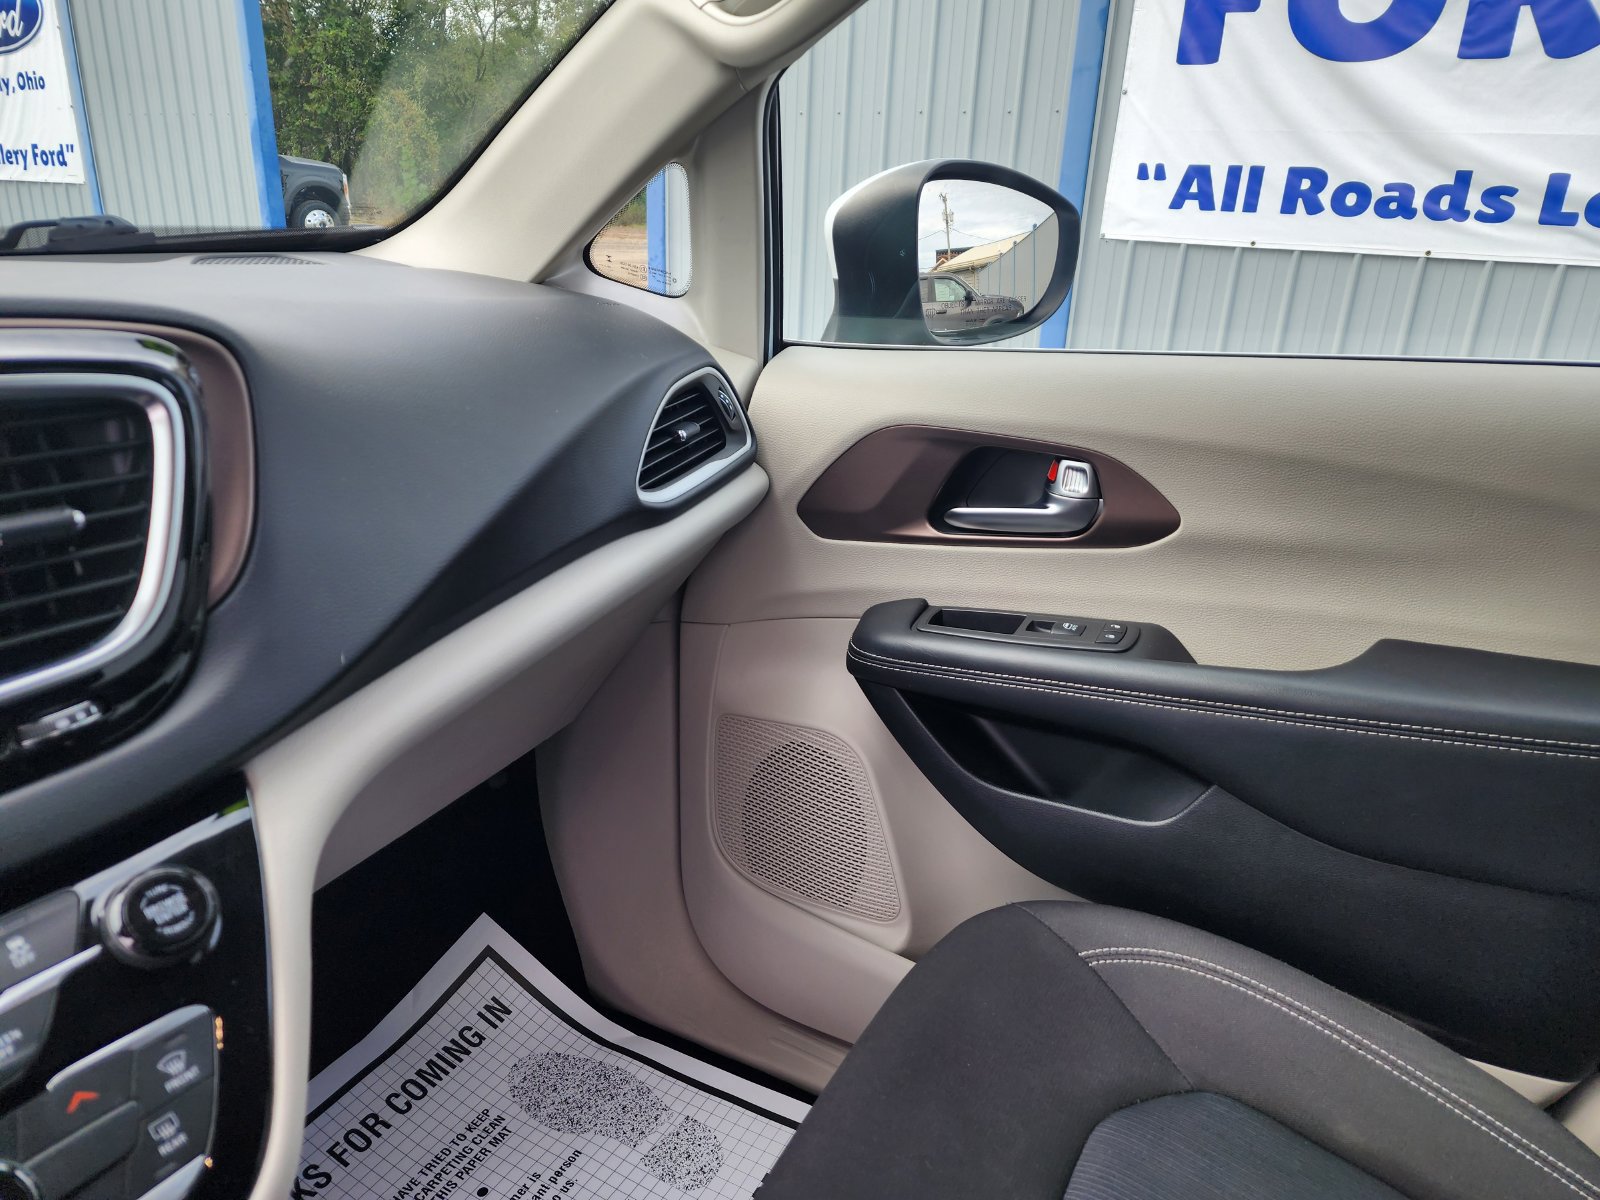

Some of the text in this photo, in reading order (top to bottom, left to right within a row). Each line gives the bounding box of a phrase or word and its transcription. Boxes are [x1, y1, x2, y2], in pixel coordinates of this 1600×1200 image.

[0, 70, 46, 96] y, Ohio
[0, 143, 74, 171] lery Ford"
[1279, 166, 1519, 224] Roads
[326, 1112, 392, 1168] FOR
[385, 1025, 487, 1115] COMING
[477, 995, 513, 1030] IN
[414, 1114, 506, 1200] CARPETING CLEAN
[418, 1147, 452, 1177] TRIED
[449, 1133, 467, 1147] TO
[465, 1108, 490, 1133] KEEP
[455, 1147, 492, 1181] PAPER
[488, 1126, 512, 1148] MAT
[527, 1172, 541, 1183] is
[548, 1149, 582, 1185] person
[560, 1179, 578, 1194] us.
